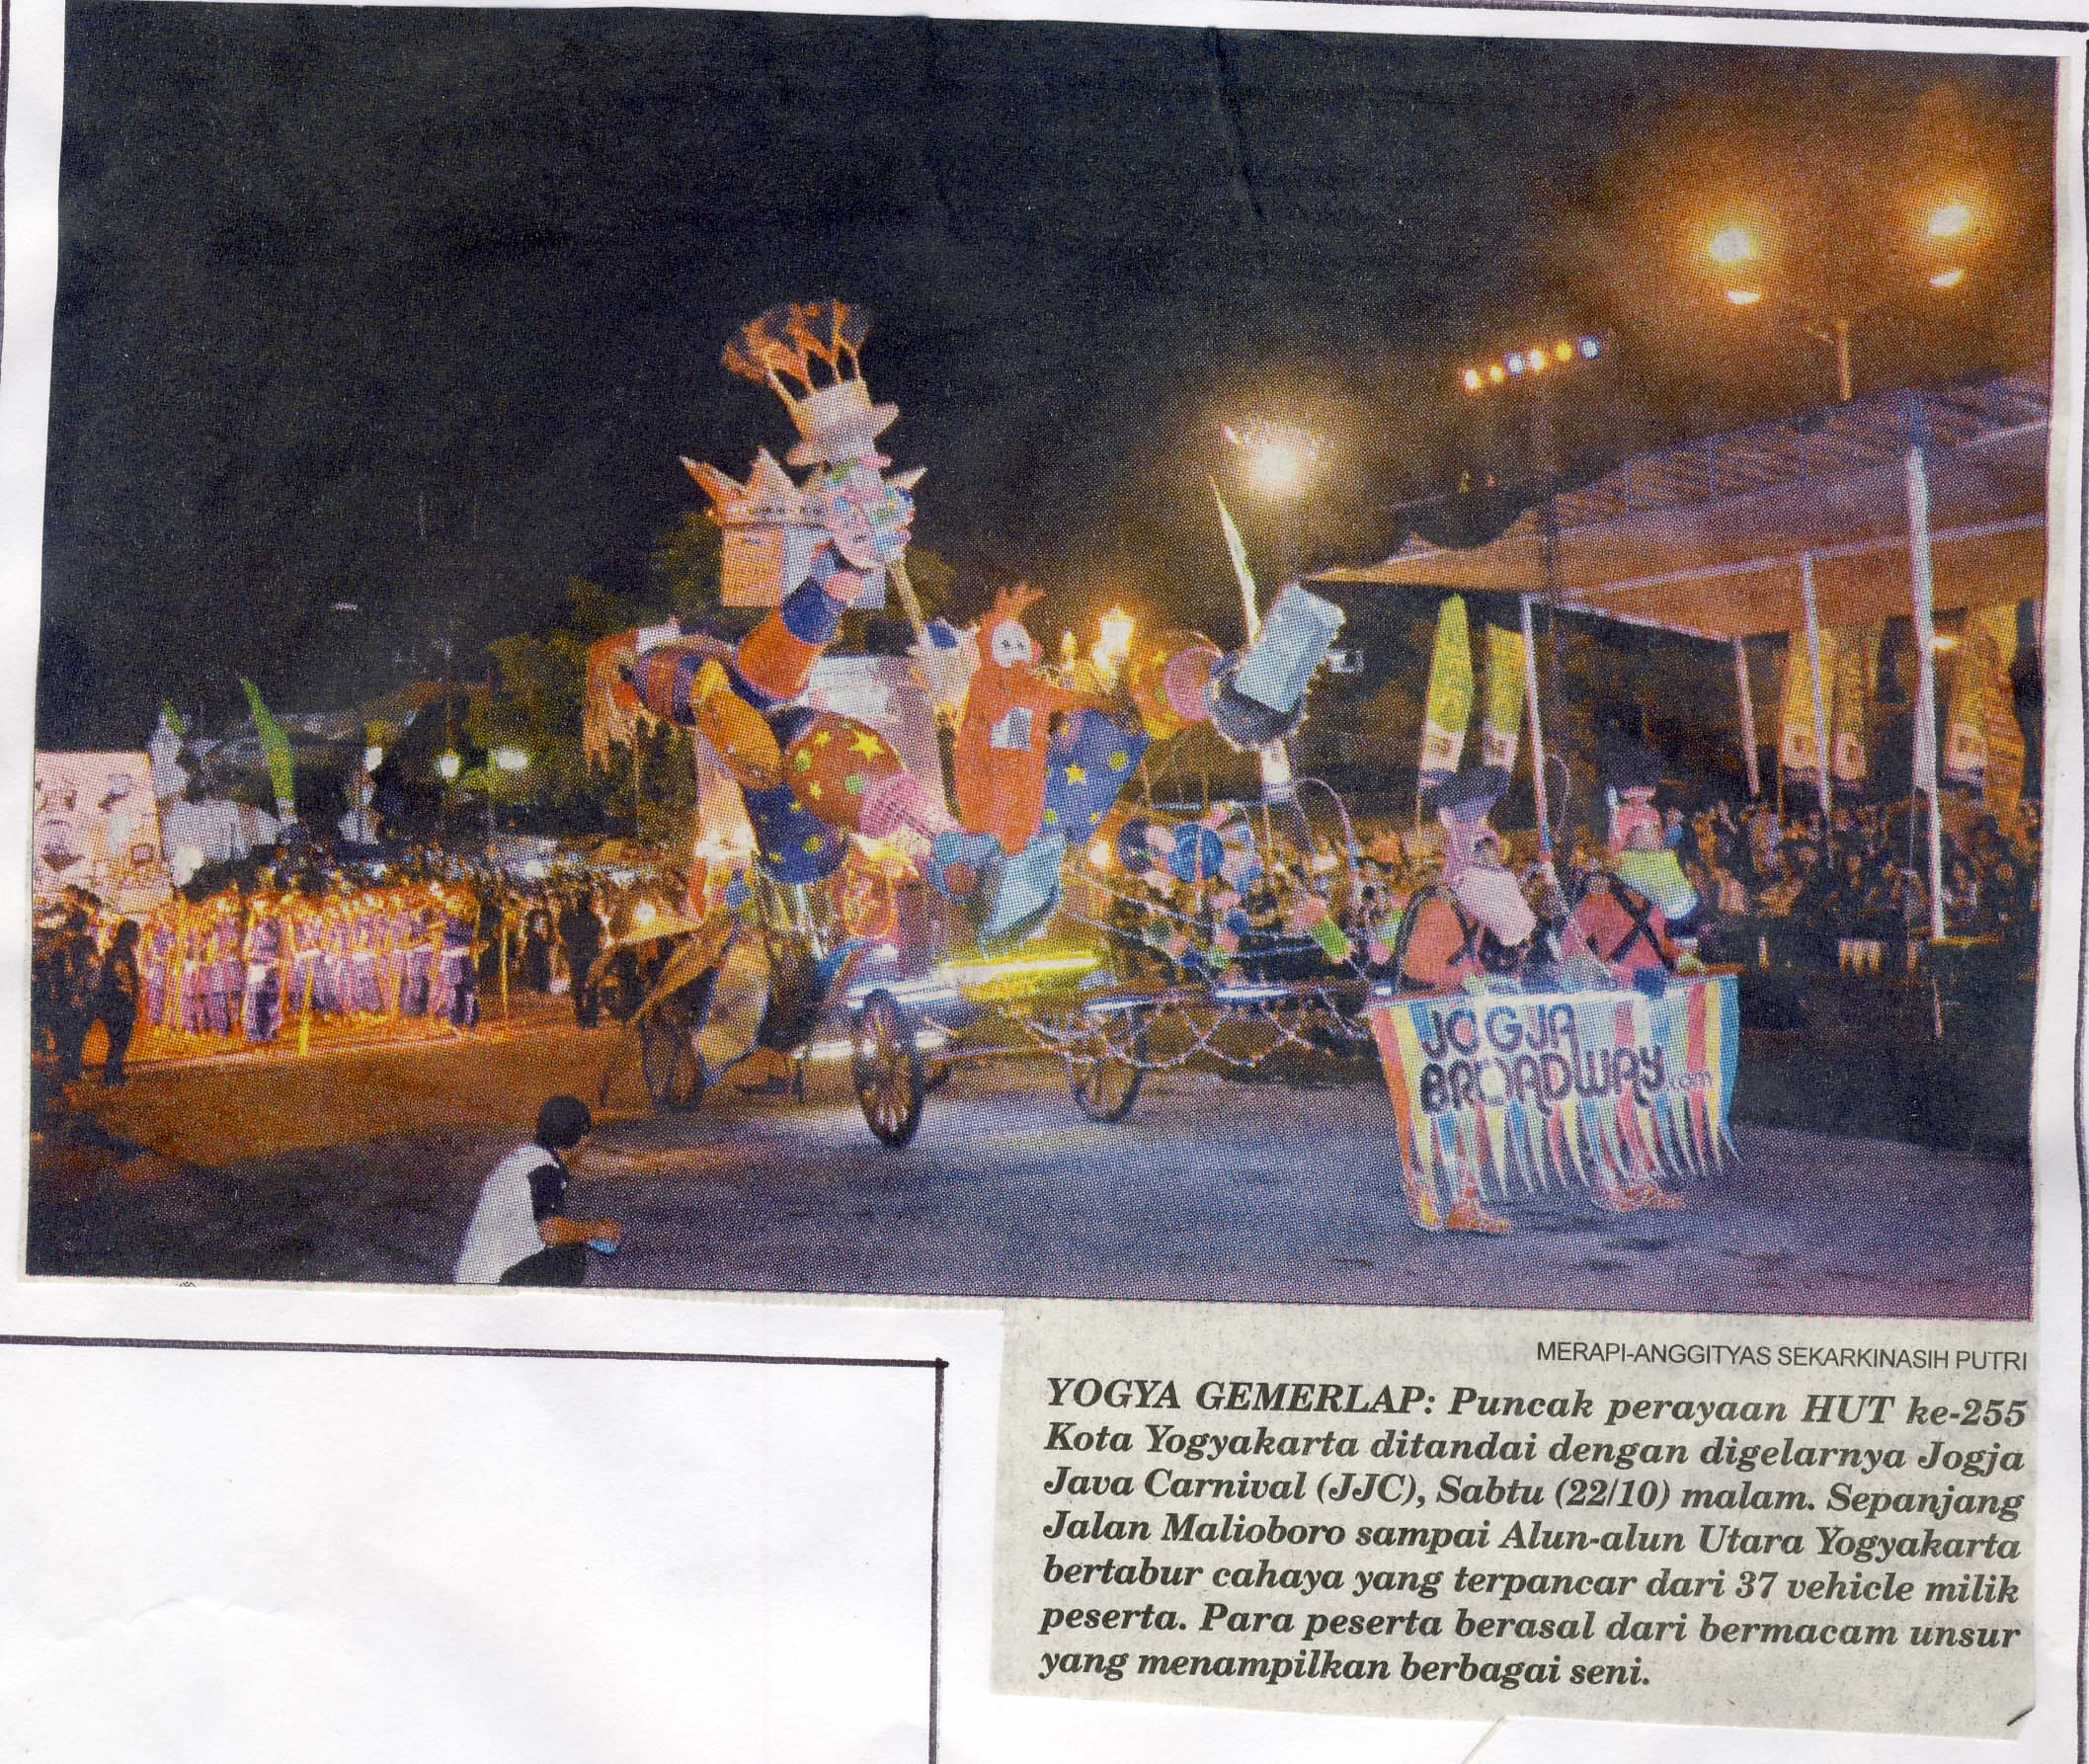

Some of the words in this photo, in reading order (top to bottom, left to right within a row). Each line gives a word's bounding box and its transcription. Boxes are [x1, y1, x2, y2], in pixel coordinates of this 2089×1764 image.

[1421, 1002, 1576, 1059] JOGJA
[1537, 1341, 1771, 1366] MERAPI-ANGGITYAS
[1777, 1346, 1949, 1369] SEKARKINASIH
[1956, 1350, 2027, 1371] PUTRI
[1047, 1377, 1181, 1409] YOGYA
[1195, 1381, 1435, 1415] GEMERLAP:
[1447, 1387, 1593, 1418] Puncak
[1603, 1399, 1788, 1427] perayaan
[1801, 1394, 1895, 1424] HUT
[1905, 1396, 2028, 1428] ke-255
[1043, 1421, 1134, 1453] Kota
[1145, 1424, 1359, 1462] Yogyakarta
[1370, 1428, 1537, 1462] ditandai
[1548, 1432, 1689, 1471] dengan
[1700, 1436, 1906, 1476] digelarnya
[1917, 1441, 2025, 1478] Jogja
[1043, 1466, 1135, 1496] Java
[1144, 1468, 1308, 1500] Carnival
[1317, 1472, 1425, 1509] (JJC),
[1435, 1474, 1545, 1506] Sabtu
[1555, 1477, 1670, 1511] (22/10)
[1680, 1481, 1815, 1511] malam.
[1826, 1482, 2025, 1522] Sepanjang
[1042, 1510, 1152, 1541] Jalan
[1161, 1512, 1346, 1546] Malioboro
[1355, 1519, 1490, 1555] sampai
[1497, 1520, 1686, 1553] Alun-alun
[1699, 1524, 1805, 1555] Utara
[1815, 1526, 2022, 1564] Yogyakarta
[1043, 1554, 1204, 1586] bertabur
[1212, 1559, 1345, 1596] cahaya
[1352, 1570, 1444, 1599] yang
[1454, 1566, 1638, 1601] terpancar
[1646, 1567, 1726, 1598] dari
[1734, 1570, 1779, 1599] 37
[1787, 1570, 1914, 1602] vehicle
[1925, 1573, 2019, 1604] milik
[1037, 1603, 1187, 1636] peserta.
[1198, 1602, 1295, 1634] Para
[1301, 1610, 1443, 1642] peserta
[1454, 1607, 1596, 1641] berasal
[1605, 1611, 1688, 1642] dari
[1699, 1613, 1898, 1645] bermacam
[1910, 1626, 2022, 1648] unsur
[1038, 1652, 1130, 1682] yang
[1137, 1648, 1392, 1685] menampilkan
[1400, 1650, 1562, 1691] berbagai
[1568, 1656, 1649, 1686] seni.
